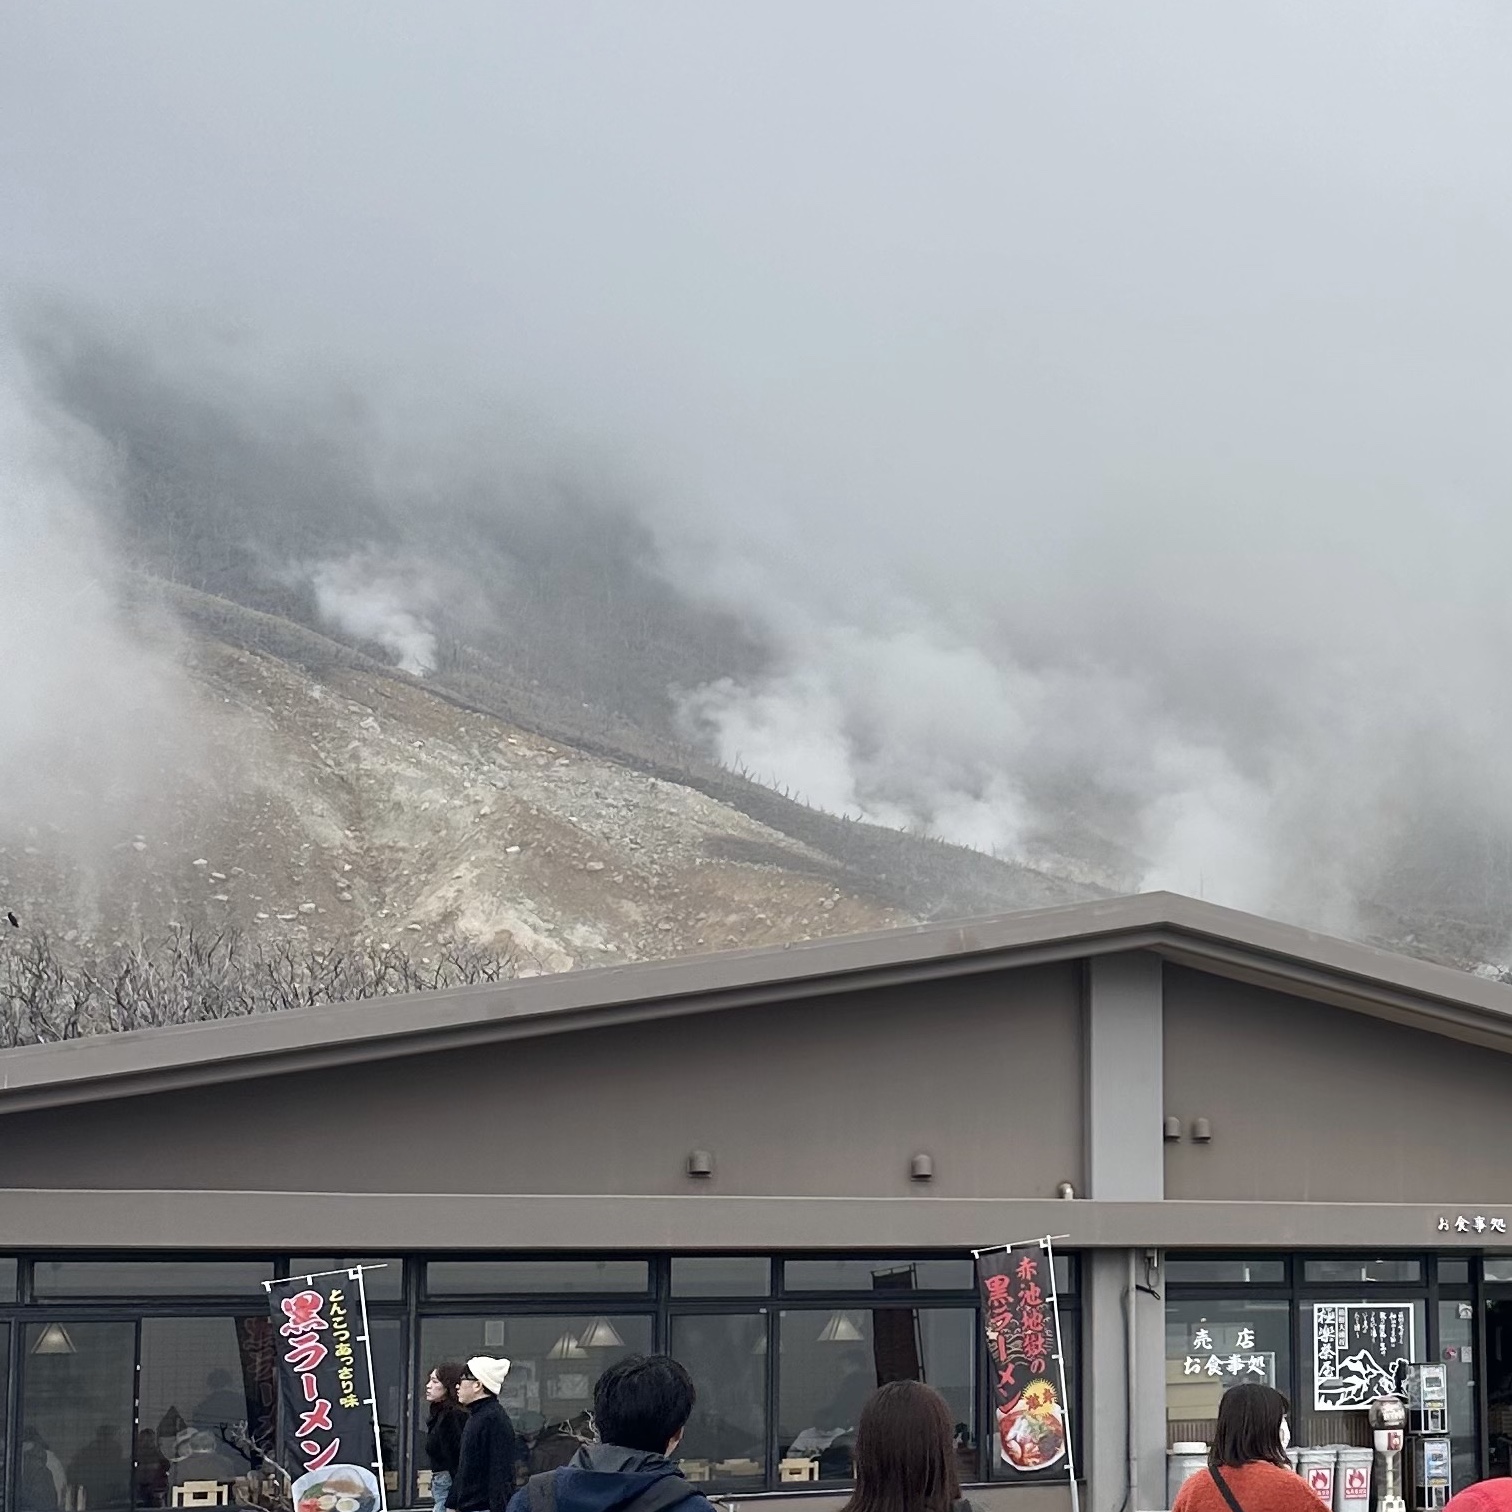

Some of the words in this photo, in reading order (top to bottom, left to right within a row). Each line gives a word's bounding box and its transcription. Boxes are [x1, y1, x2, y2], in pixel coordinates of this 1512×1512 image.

[1438, 1215, 1506, 1233] お食事処
[329, 1288, 360, 1409] とんこつあっさり味
[984, 1274, 1022, 1414] 黒ラーメン
[1183, 1353, 1266, 1377] お食事処
[1193, 1327, 1255, 1350] 売店
[280, 1290, 340, 1472] 黒ラーメン
